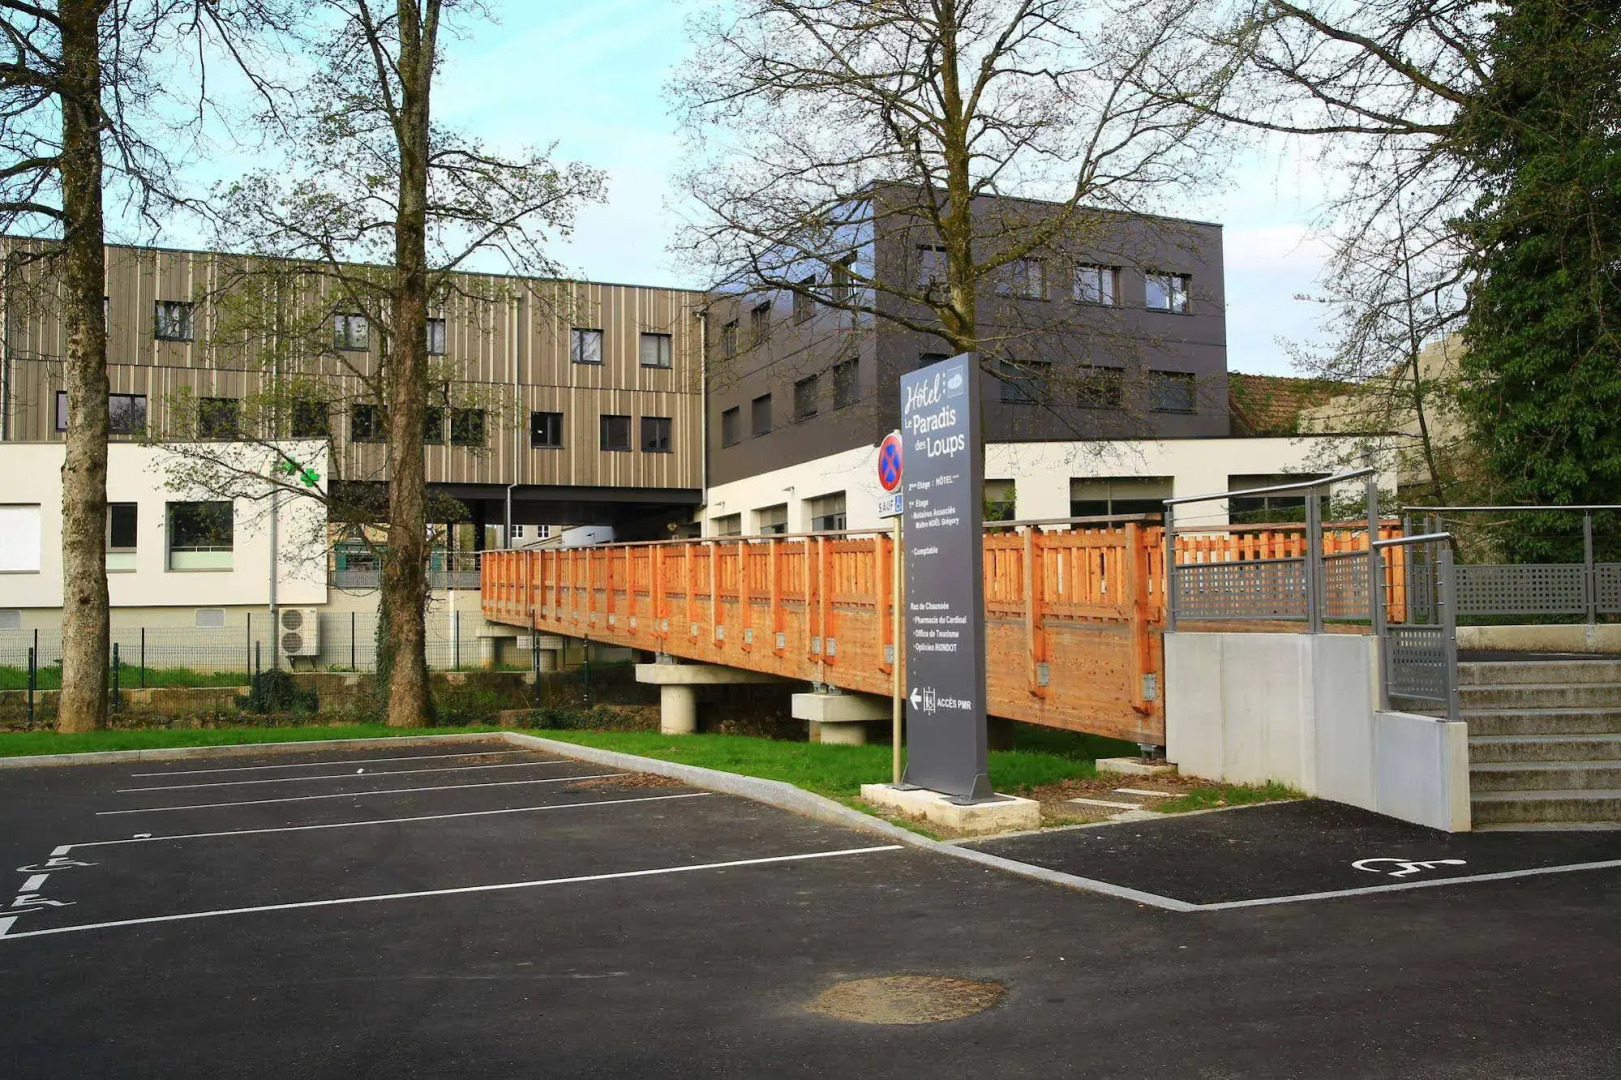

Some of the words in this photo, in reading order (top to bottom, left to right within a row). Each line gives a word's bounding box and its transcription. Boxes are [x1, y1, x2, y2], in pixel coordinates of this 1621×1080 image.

[905, 373, 941, 414] Hôtel
[905, 419, 912, 429] Le
[913, 405, 956, 435] Paradis
[915, 439, 926, 451] des
[927, 434, 965, 458] Loups
[878, 499, 893, 513] SAUF
[932, 506, 956, 517] Associés
[914, 546, 938, 556] Comptable
[914, 616, 938, 624] Pharmacie
[938, 616, 946, 624] du
[946, 616, 966, 624] Cardinal
[915, 630, 929, 638] Office
[930, 630, 936, 638] de
[936, 630, 960, 638] Tourisme
[915, 643, 934, 652] Opticien
[937, 697, 956, 709] ACCÈS
[957, 700, 972, 710] PMR
